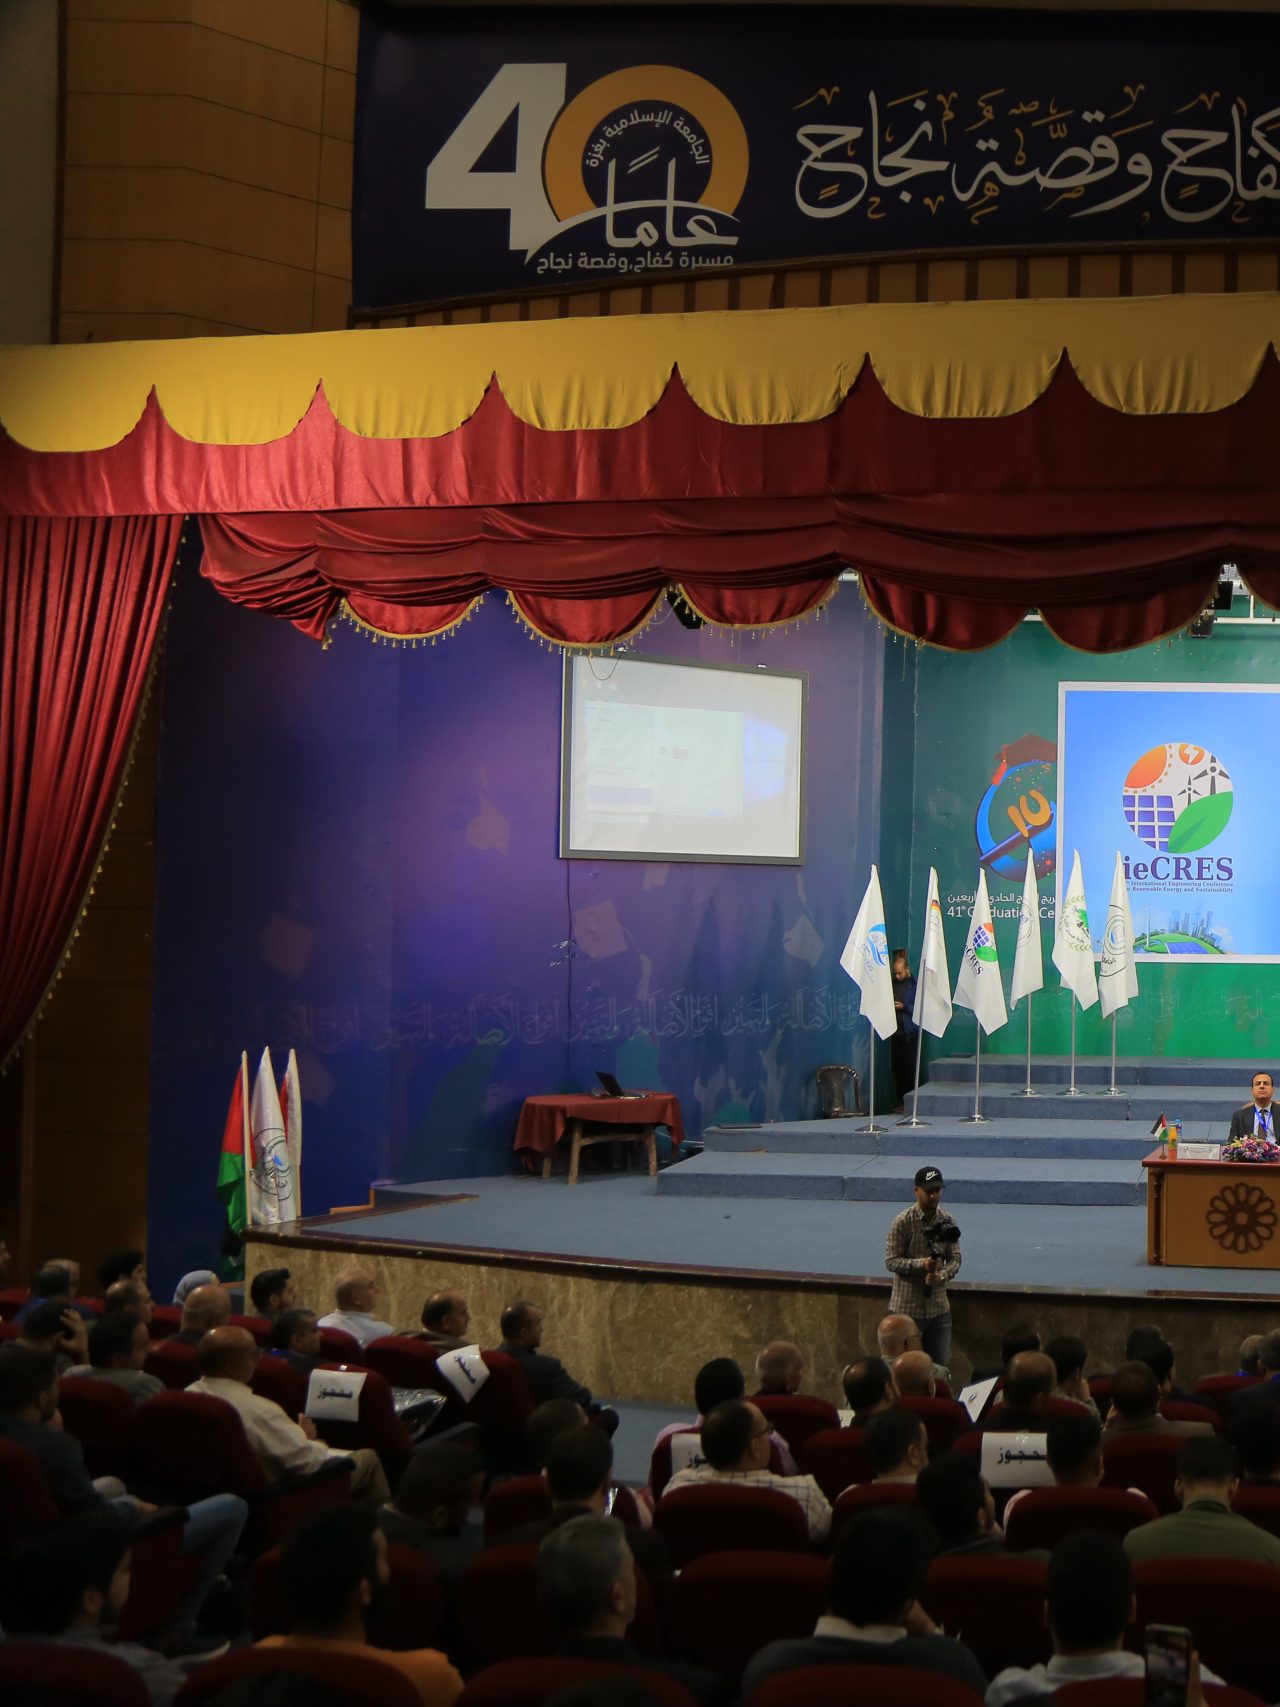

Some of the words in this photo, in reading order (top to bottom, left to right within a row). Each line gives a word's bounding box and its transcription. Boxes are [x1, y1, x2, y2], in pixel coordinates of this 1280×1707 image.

[673, 115, 710, 166] الجامعة
[1122, 855, 1234, 881] ieCRES
[996, 1446, 1047, 1465] حجوز
